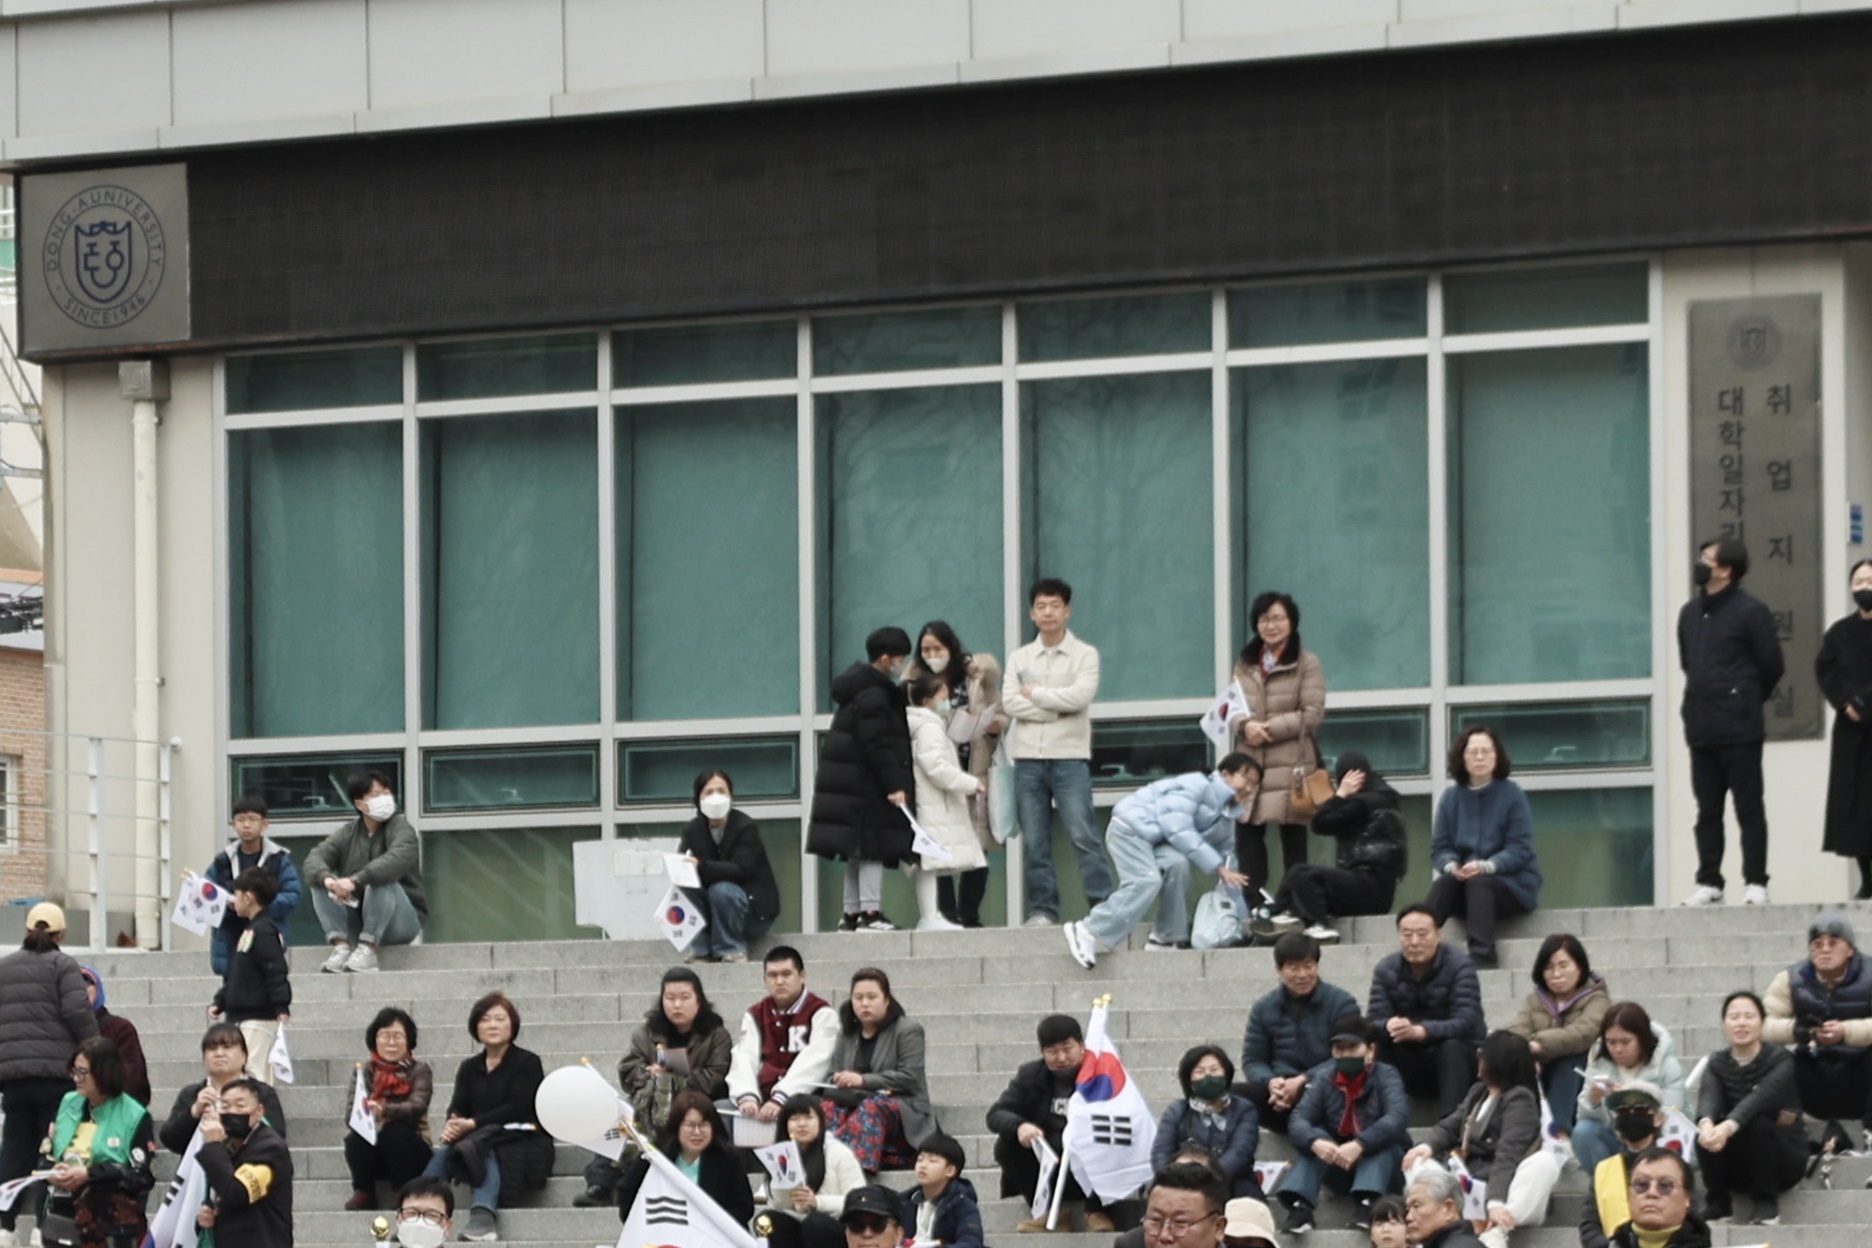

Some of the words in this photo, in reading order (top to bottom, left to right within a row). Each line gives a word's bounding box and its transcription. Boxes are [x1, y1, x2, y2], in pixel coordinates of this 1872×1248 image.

[64, 298, 110, 324] SINCE
[113, 296, 145, 320] 1946
[1765, 383, 1793, 718] 취업지원실
[788, 1025, 809, 1052] K
